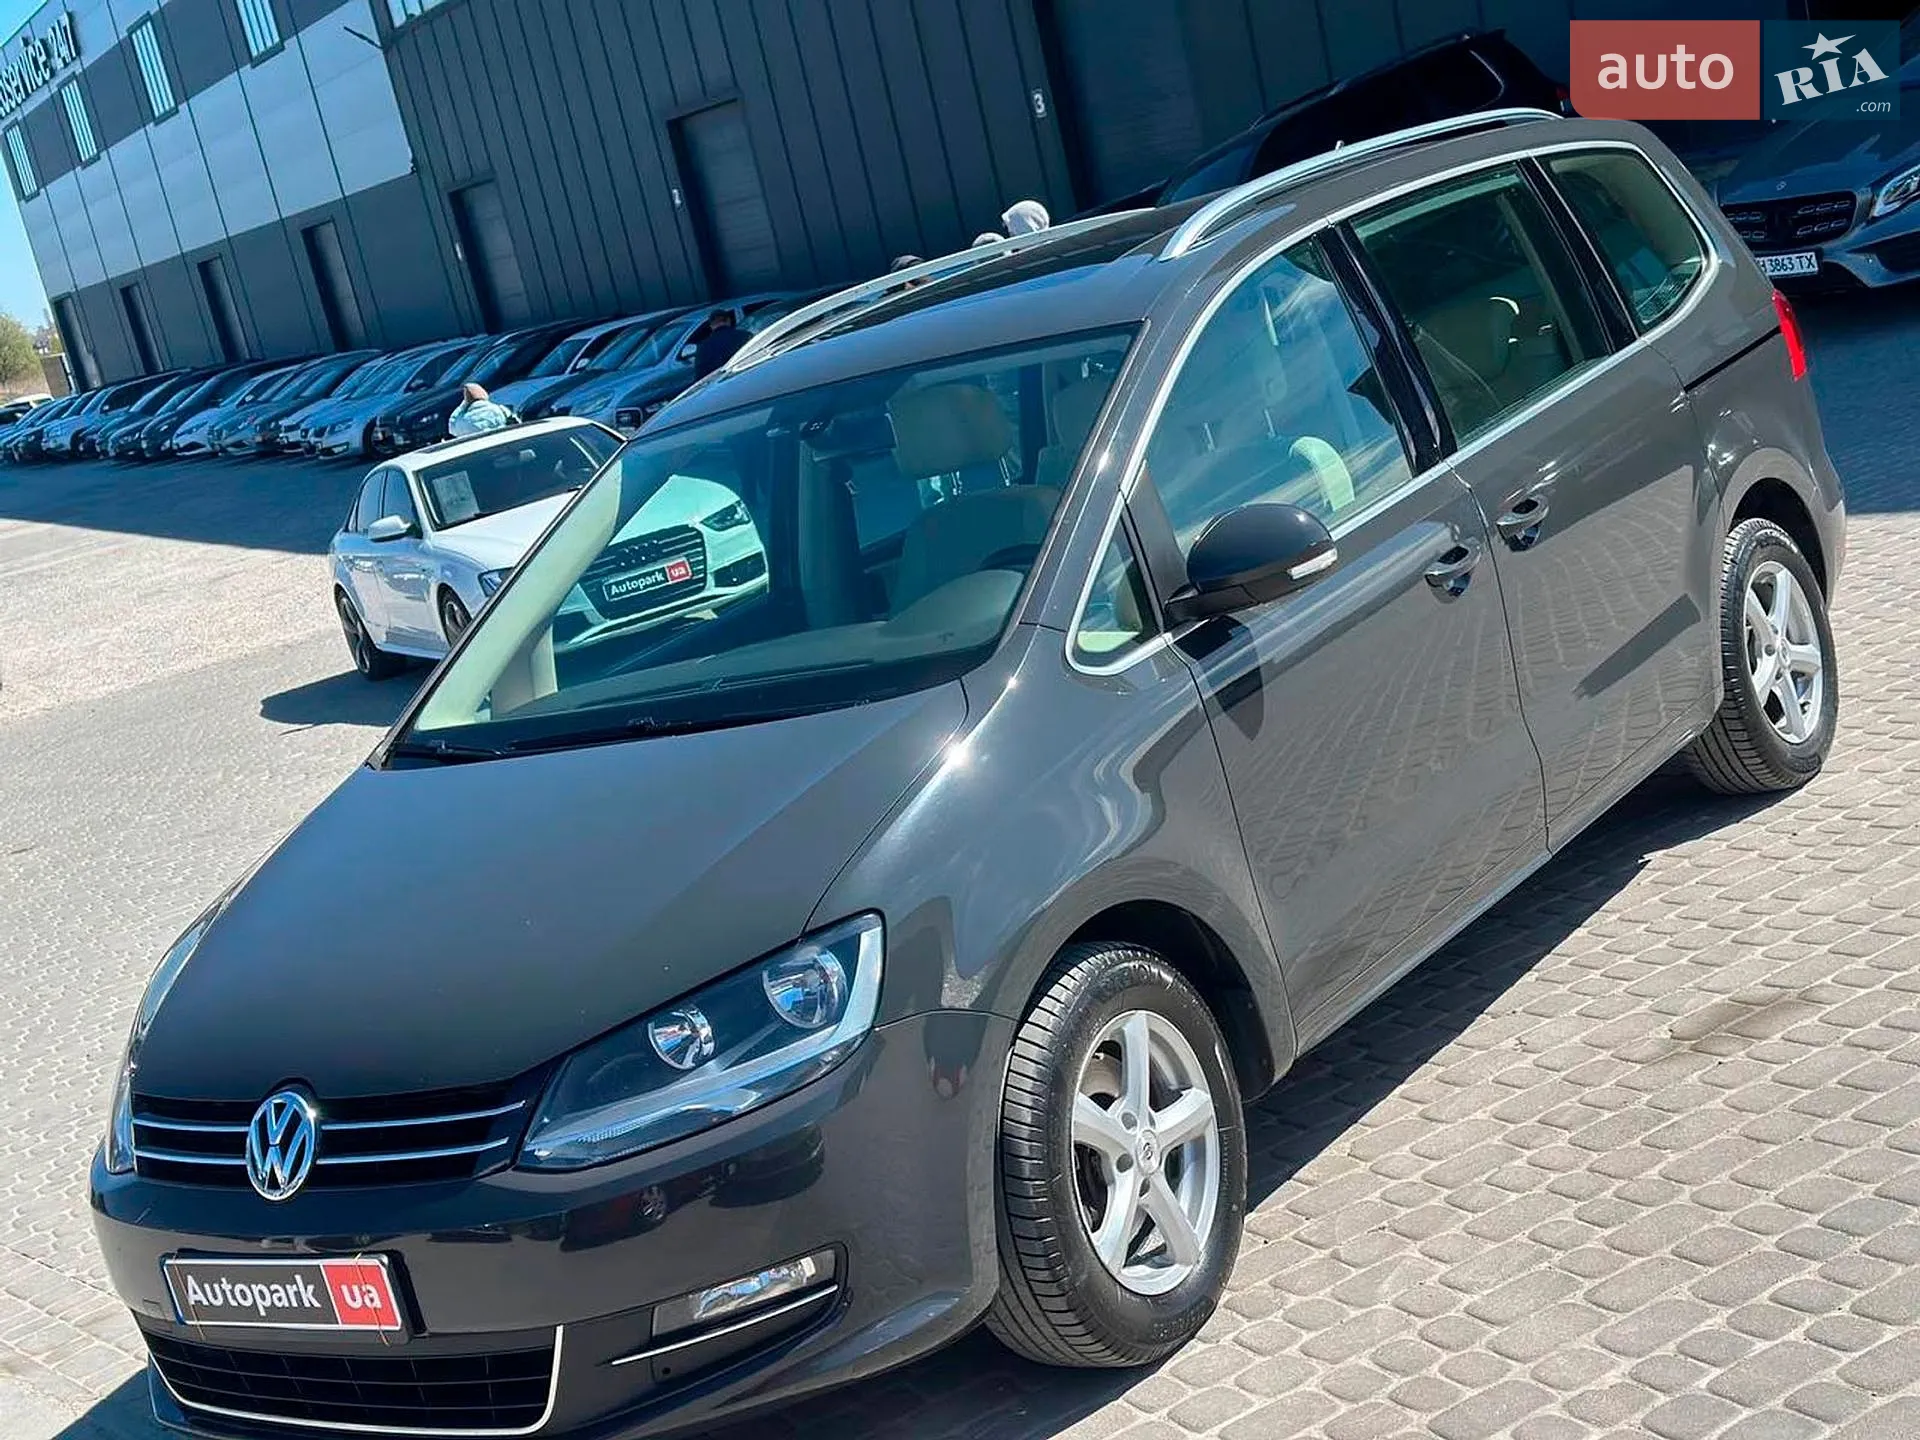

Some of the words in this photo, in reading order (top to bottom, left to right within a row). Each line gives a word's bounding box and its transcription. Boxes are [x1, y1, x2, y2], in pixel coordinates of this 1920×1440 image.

[0, 37, 50, 117] oservice
[1033, 93, 1046, 114] 3
[1767, 256, 1795, 273] 3863
[1796, 254, 1816, 270] TX
[611, 572, 665, 596] Autopark
[670, 568, 687, 578] ua
[187, 1274, 321, 1316] Autopark
[342, 1284, 382, 1310] ua
